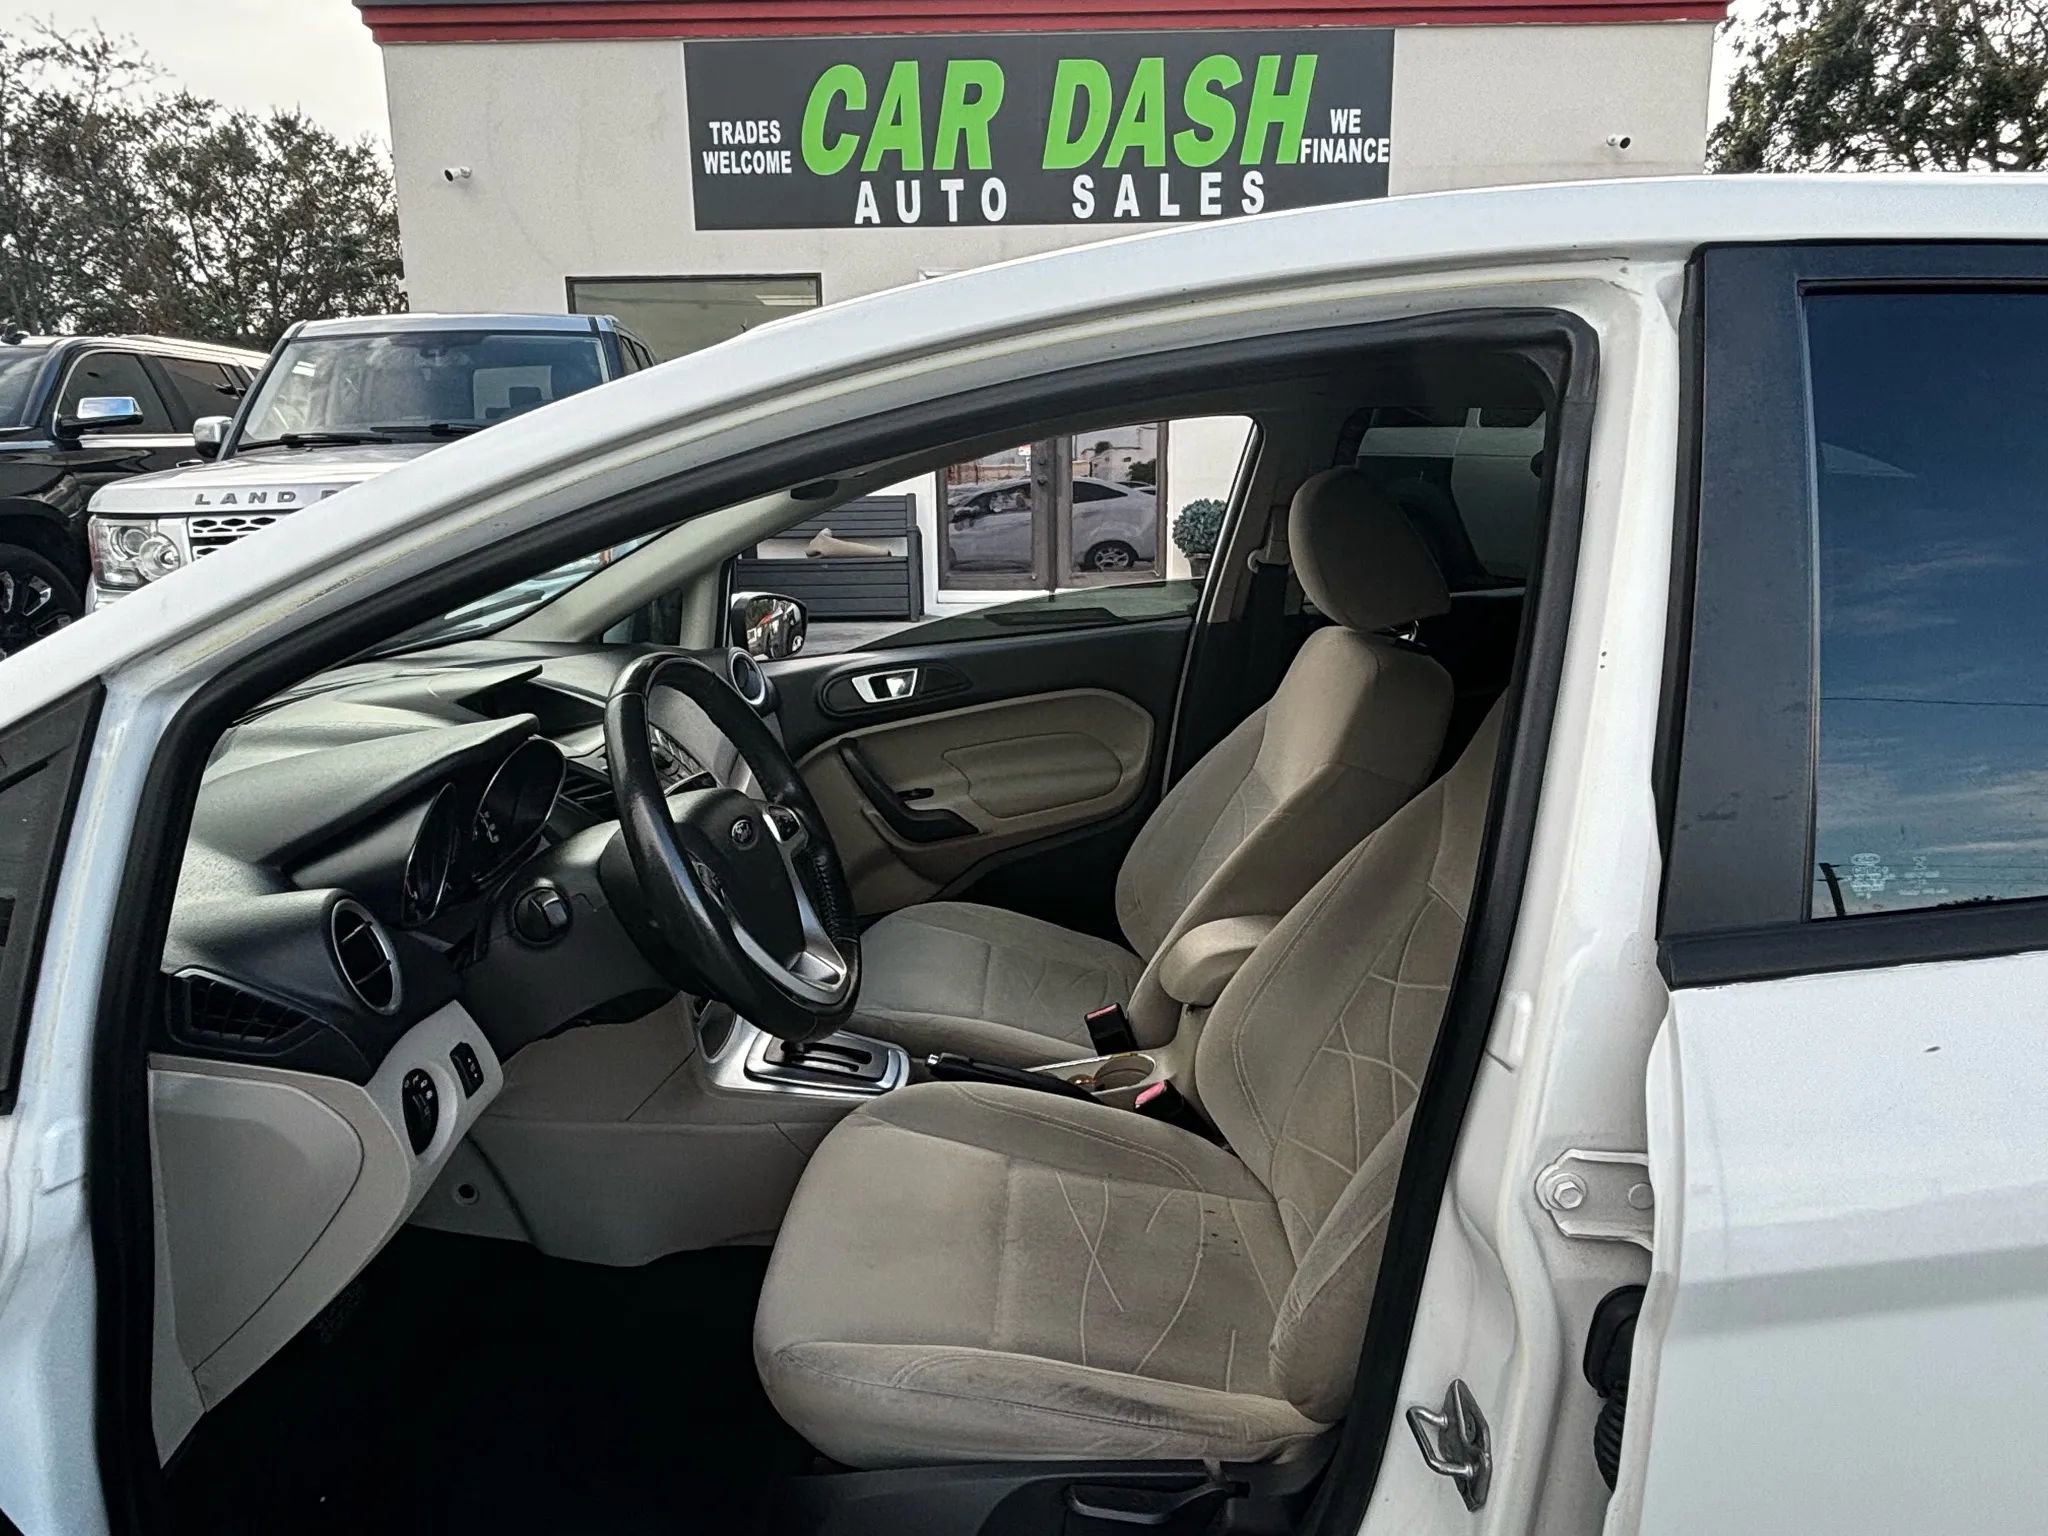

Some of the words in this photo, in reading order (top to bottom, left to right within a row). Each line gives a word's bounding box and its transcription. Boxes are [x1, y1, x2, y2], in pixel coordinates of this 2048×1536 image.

[800, 58, 1004, 176] CAR
[1041, 54, 1318, 170] DASH
[1329, 108, 1362, 135] WE
[708, 120, 782, 145] TRADES
[702, 150, 793, 176] WELCOME
[1300, 137, 1390, 165] FINANCE
[854, 176, 1007, 225] AUTO
[1071, 170, 1266, 219] SALES
[195, 491, 297, 505] LAND
